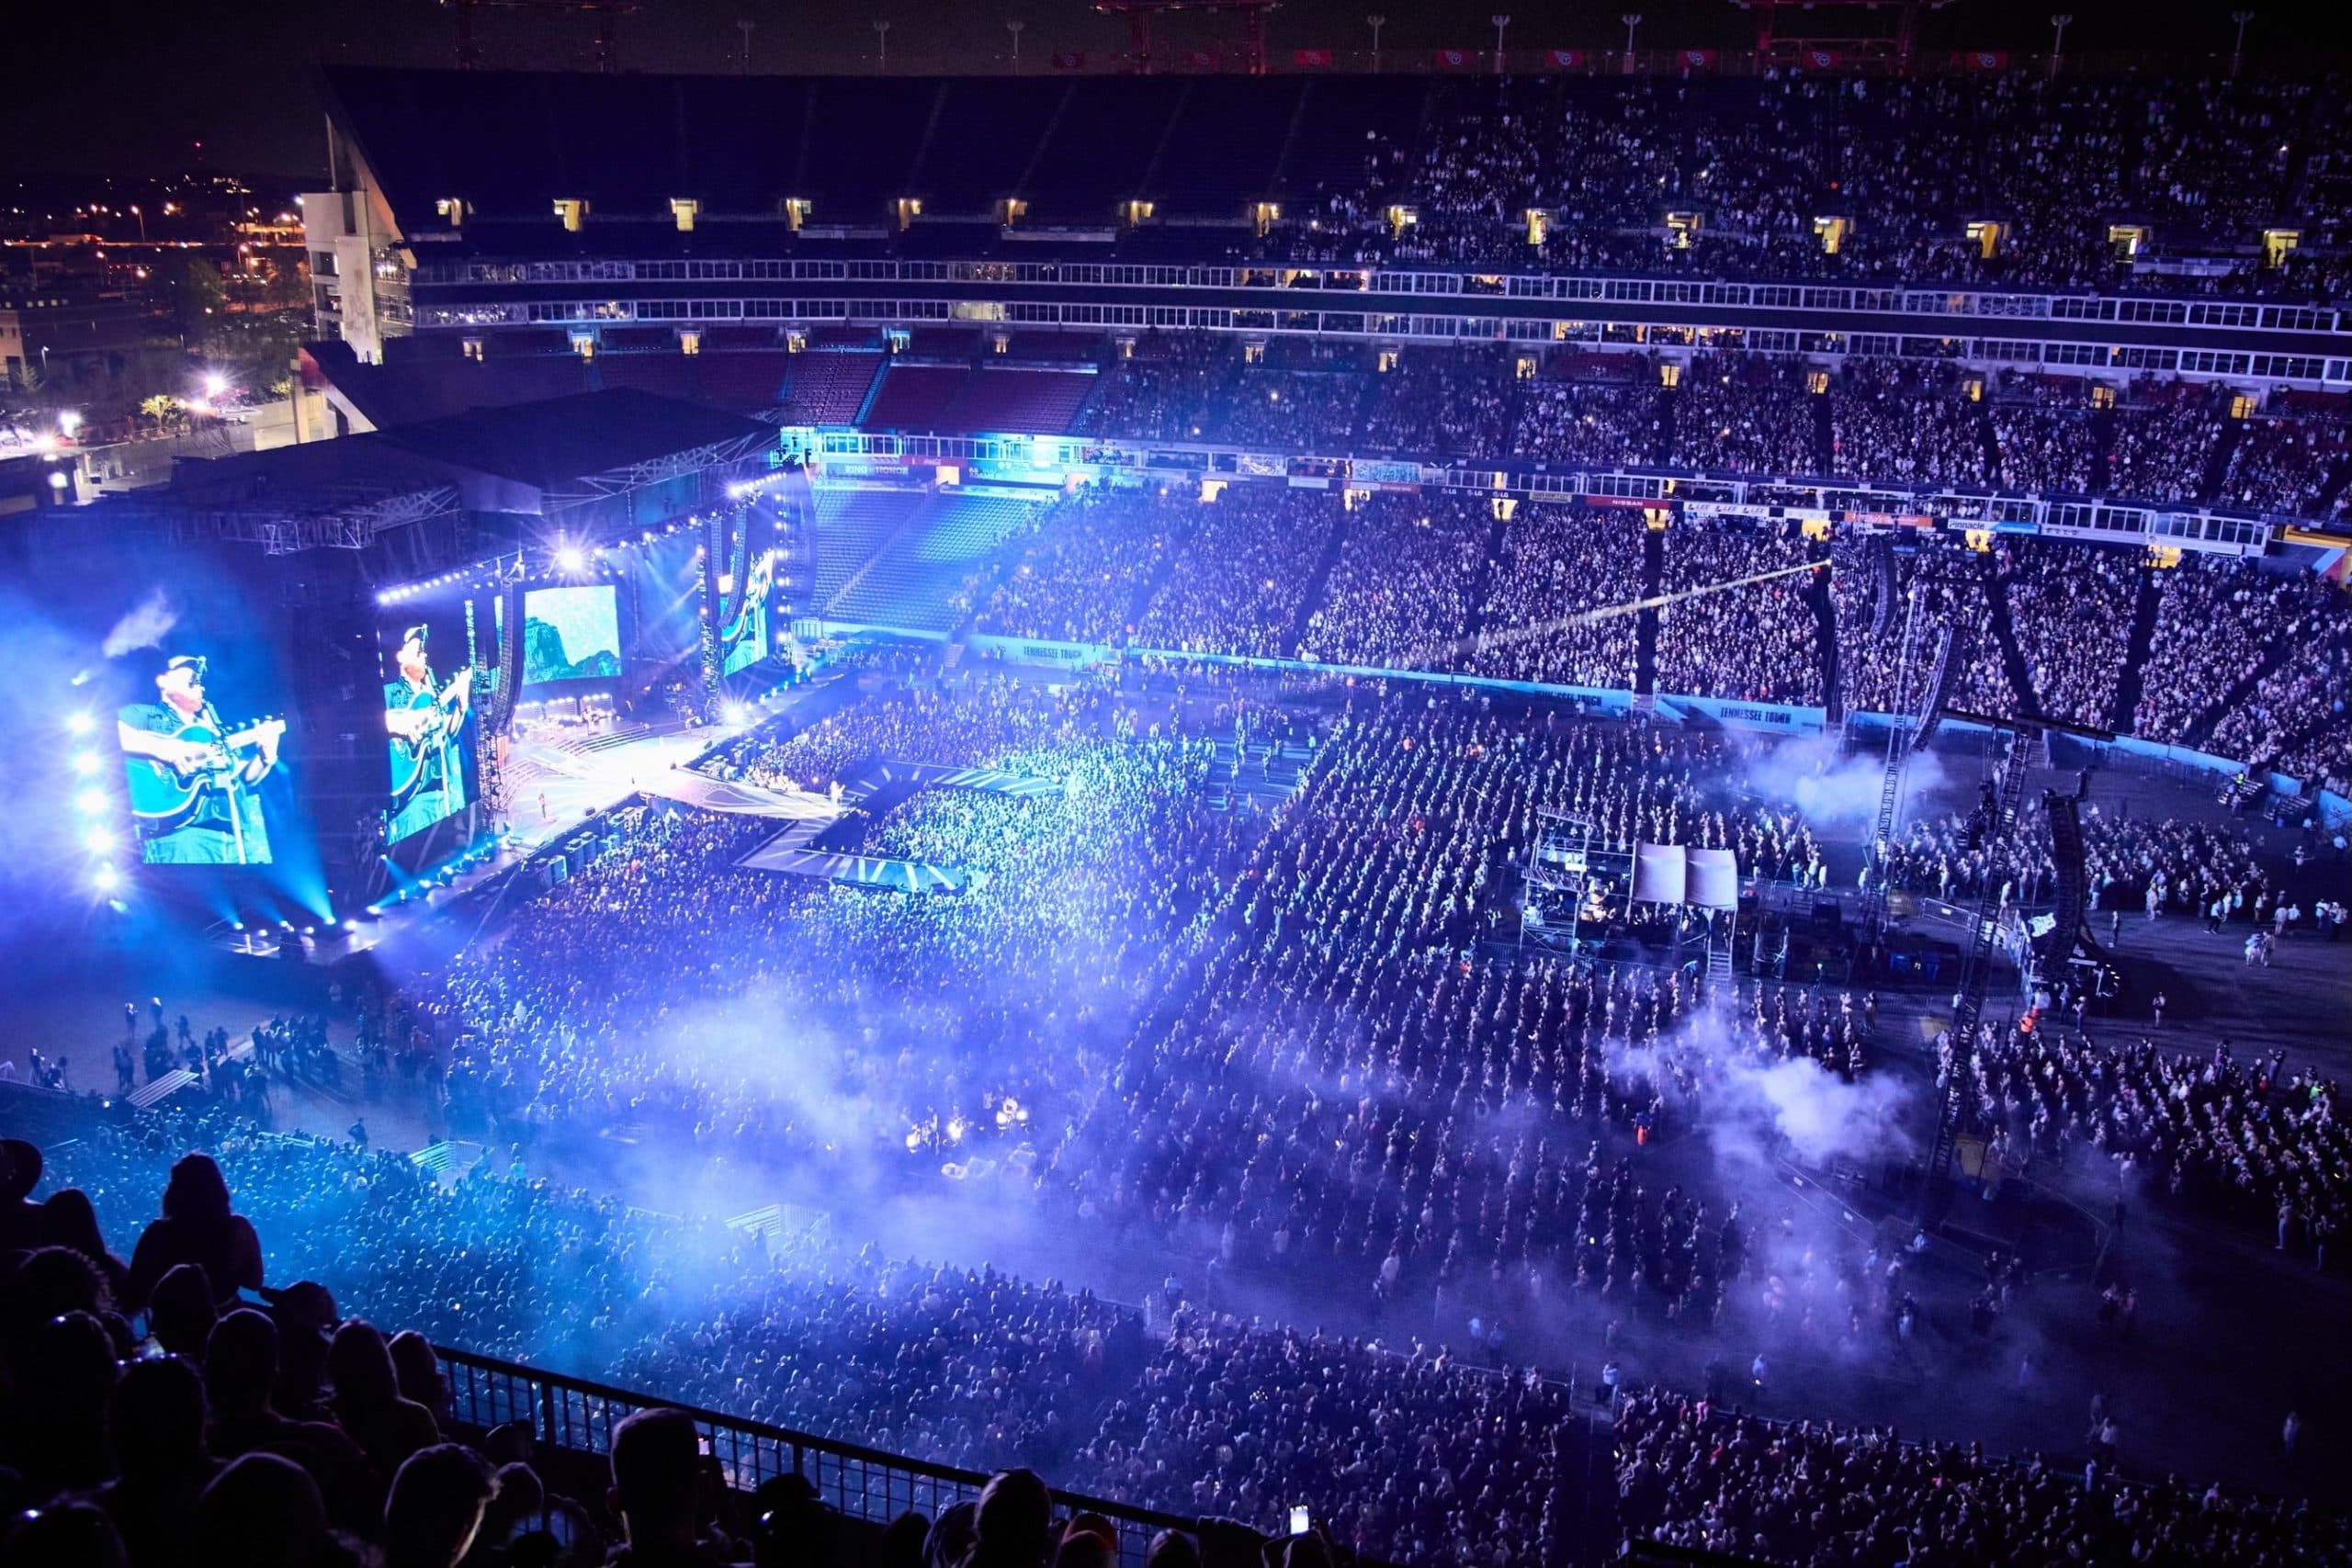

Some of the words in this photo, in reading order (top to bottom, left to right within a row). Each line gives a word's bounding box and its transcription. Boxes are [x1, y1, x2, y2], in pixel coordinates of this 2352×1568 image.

[1949, 520, 1984, 530] Pinnacle
[1060, 649, 1081, 660] TOU
[1720, 706, 1762, 721] TENNESSEE
